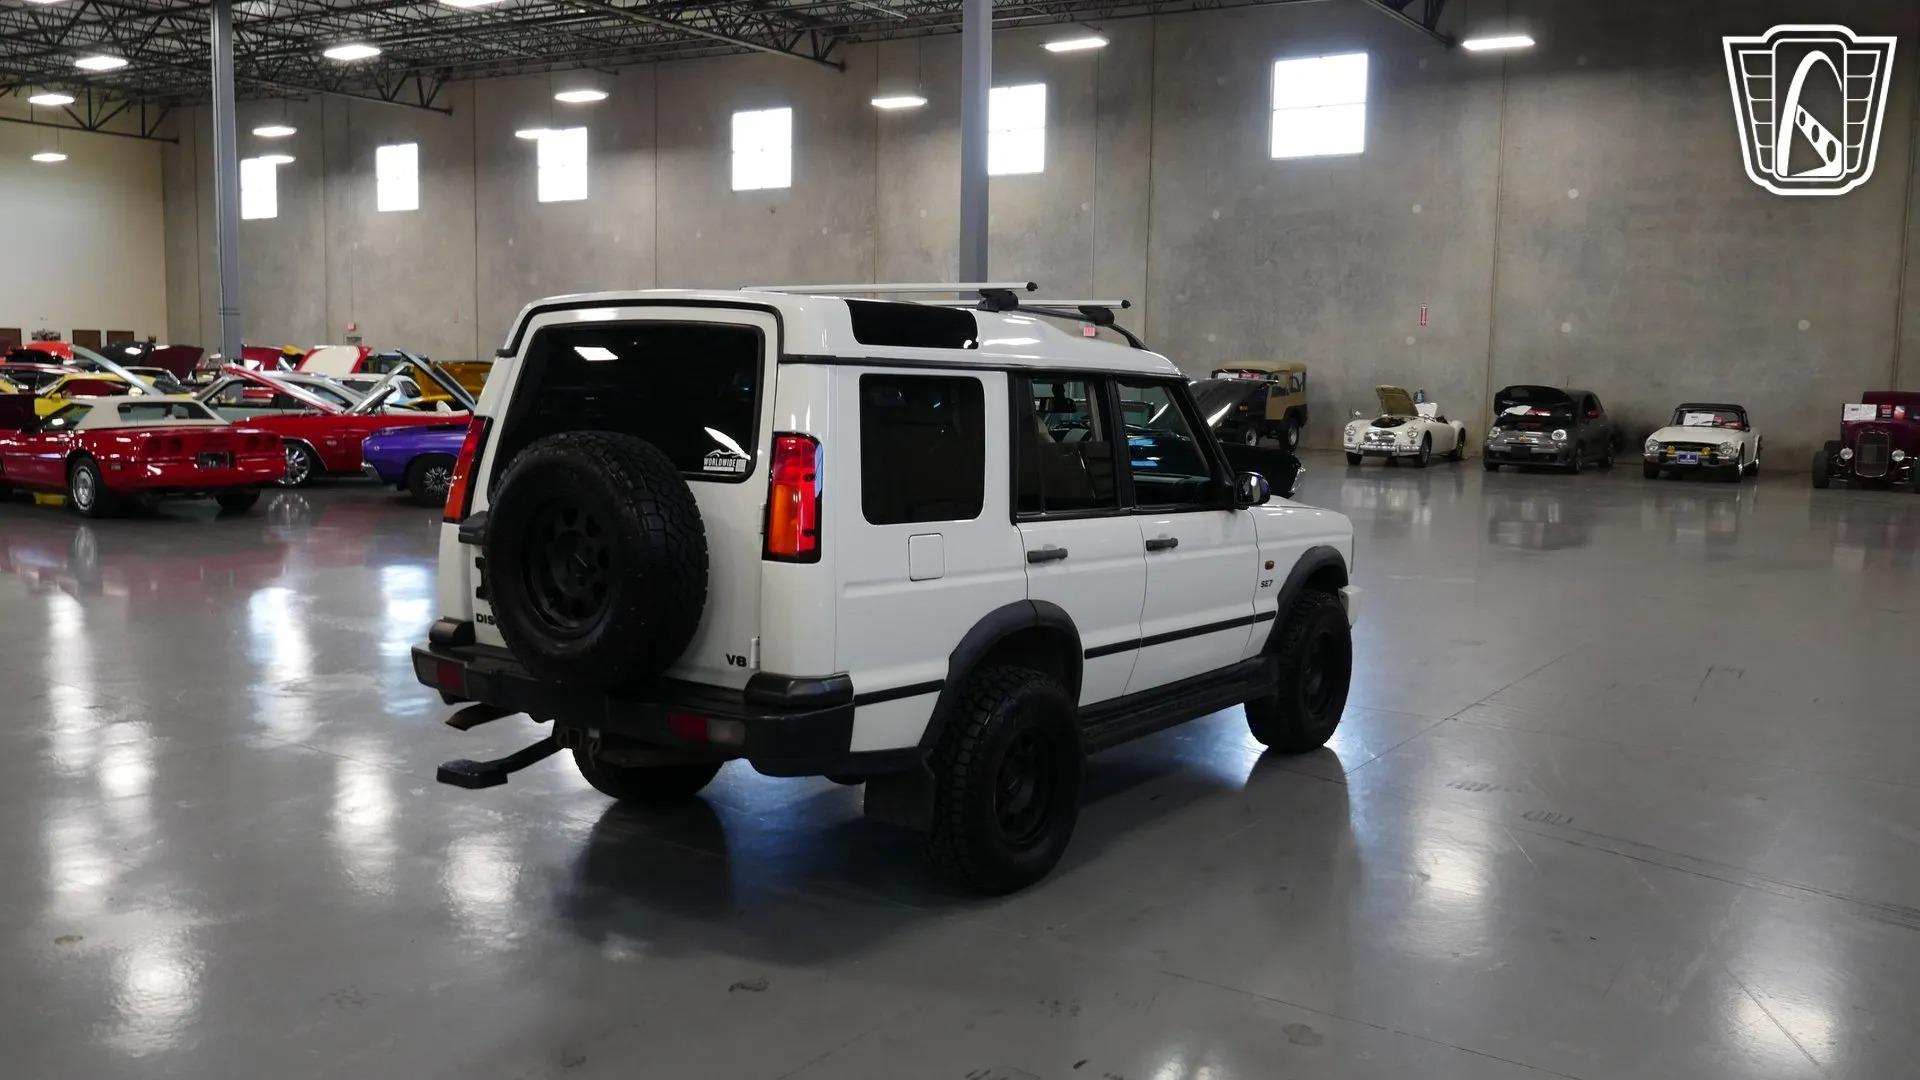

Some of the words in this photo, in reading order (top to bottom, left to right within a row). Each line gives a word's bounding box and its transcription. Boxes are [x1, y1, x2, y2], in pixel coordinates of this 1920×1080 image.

[704, 457, 736, 467] WORLDWIDE
[1260, 579, 1273, 588] SE7
[726, 654, 747, 667] V8
